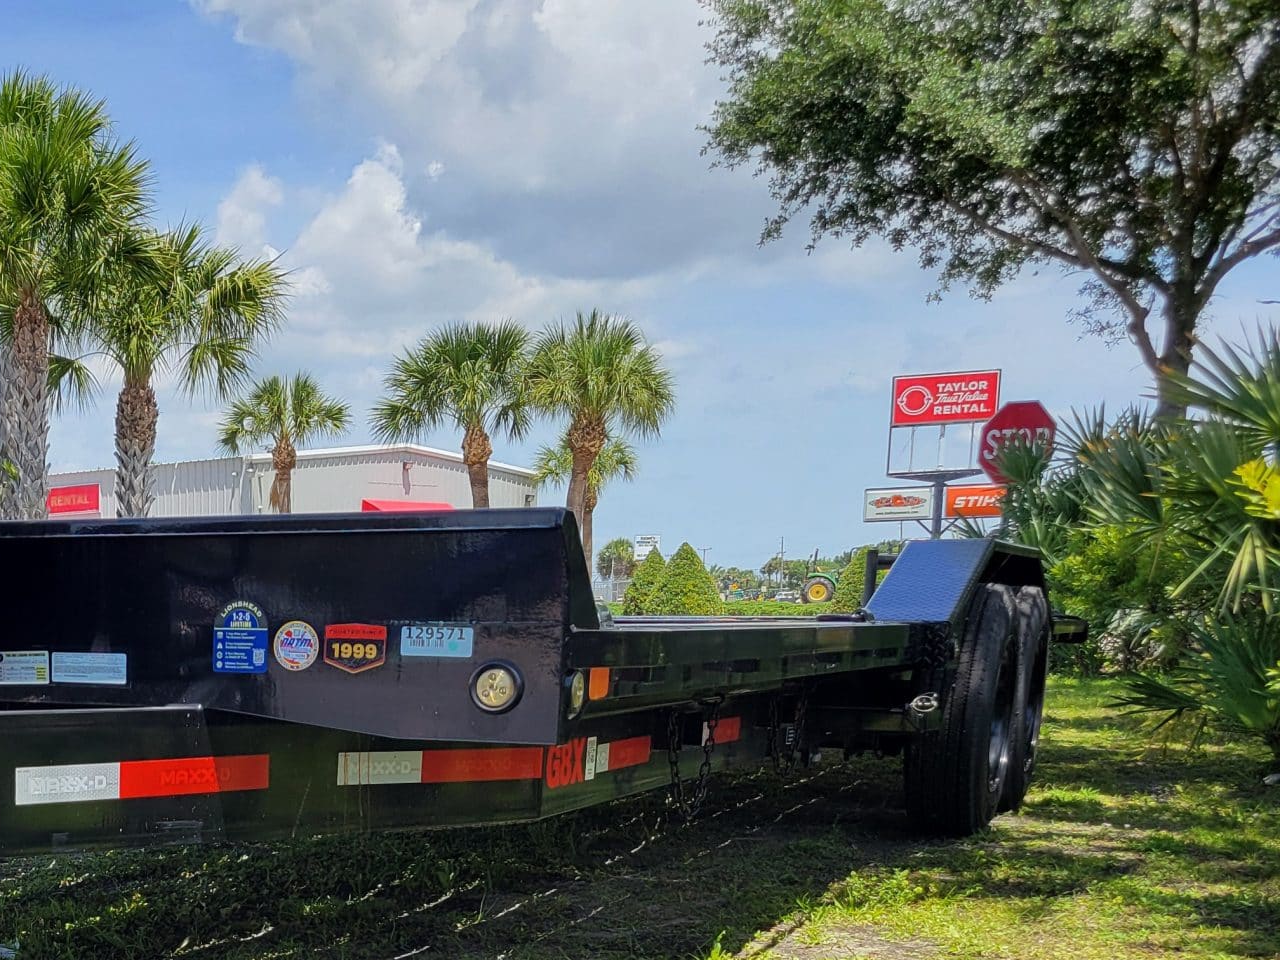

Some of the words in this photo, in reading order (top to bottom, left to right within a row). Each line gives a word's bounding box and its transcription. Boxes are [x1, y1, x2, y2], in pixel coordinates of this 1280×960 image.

[936, 380, 989, 393] TAYLOR
[50, 494, 90, 508] RENTAL
[220, 600, 263, 618] LIONSHEAD
[405, 626, 466, 641] 129571
[331, 643, 378, 659] 1999
[30, 775, 107, 795] MAXX-D
